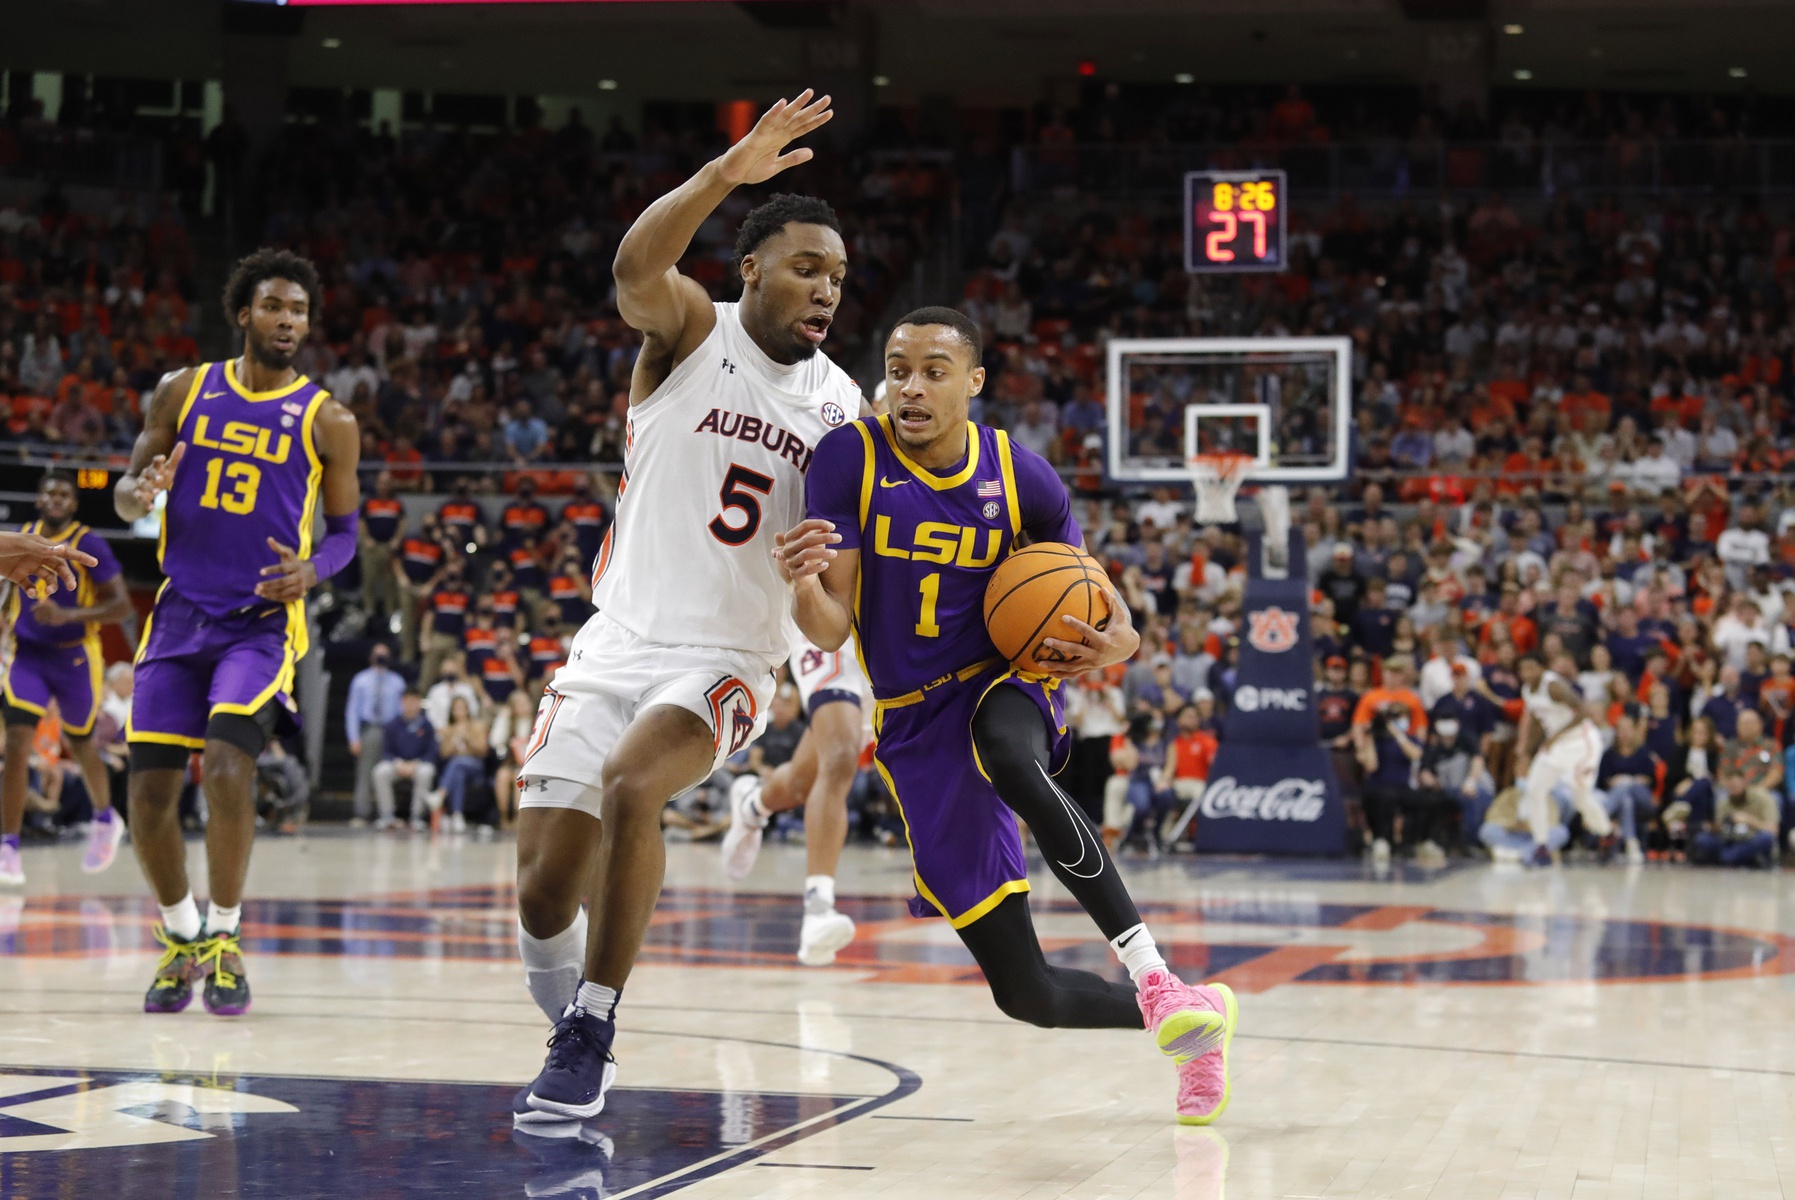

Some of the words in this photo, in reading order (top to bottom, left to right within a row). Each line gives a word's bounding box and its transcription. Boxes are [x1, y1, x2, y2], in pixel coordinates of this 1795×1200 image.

[1213, 181, 1276, 211] 8:26
[1206, 211, 1267, 262] 27
[192, 414, 292, 464] LSU
[823, 403, 844, 425] SEC
[199, 457, 262, 515] 13
[708, 462, 775, 546] 5
[984, 502, 999, 518] SEC
[874, 514, 1003, 568] LSU
[915, 573, 940, 638] 1
[923, 673, 952, 691] LSU
[1259, 687, 1307, 711] PNC
